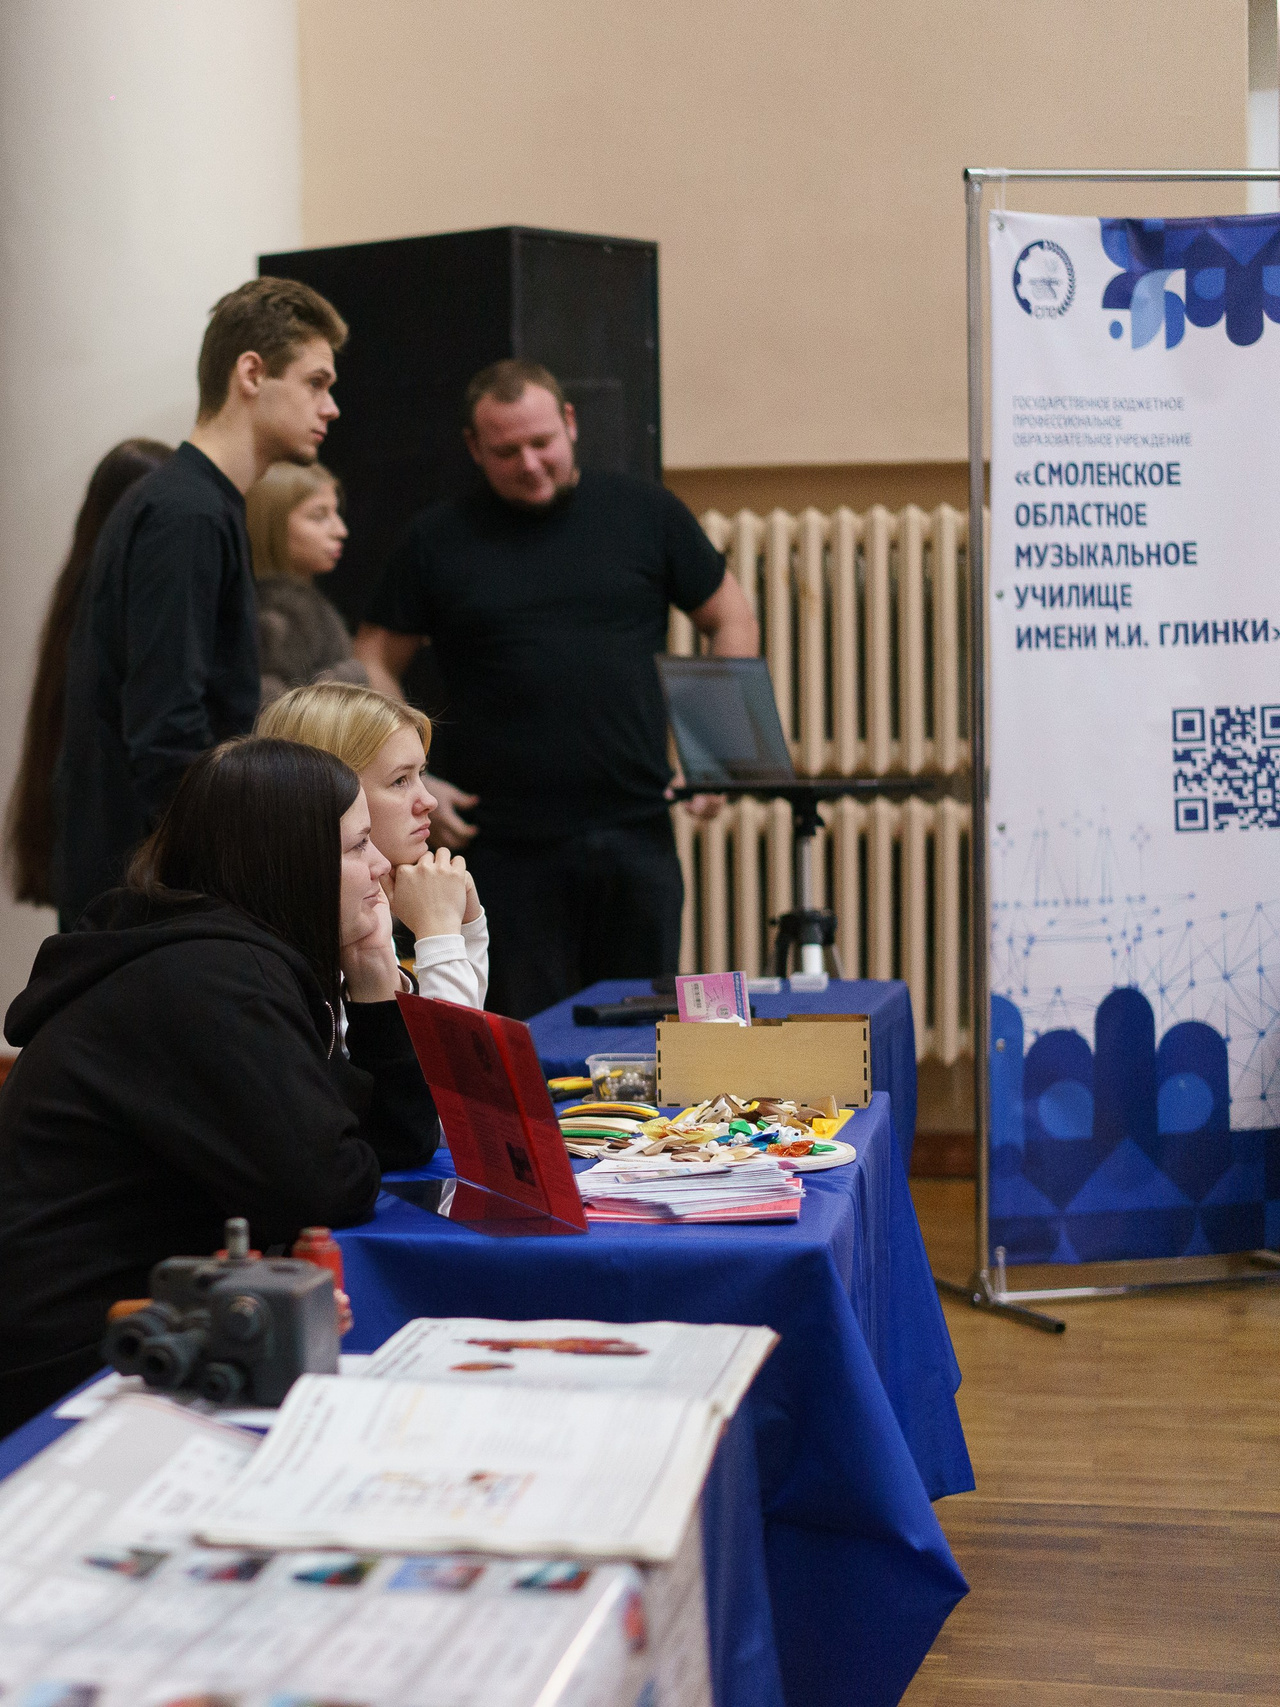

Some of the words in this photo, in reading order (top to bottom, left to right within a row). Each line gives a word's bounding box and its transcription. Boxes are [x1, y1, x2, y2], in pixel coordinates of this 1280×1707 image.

[1113, 396, 1185, 412] БЮДЖЕТНОЕ
[1014, 461, 1182, 486] «СМОЛЕНСКОЕ
[1014, 502, 1148, 527] ОБЛАСТНОЕ
[1014, 541, 1198, 568] МУЗЫКАЛЬНОЕ
[1014, 582, 1133, 612] УЧИЛИЩЕ
[1016, 624, 1097, 650] ИМЕНИ
[1105, 623, 1149, 648] М.И.
